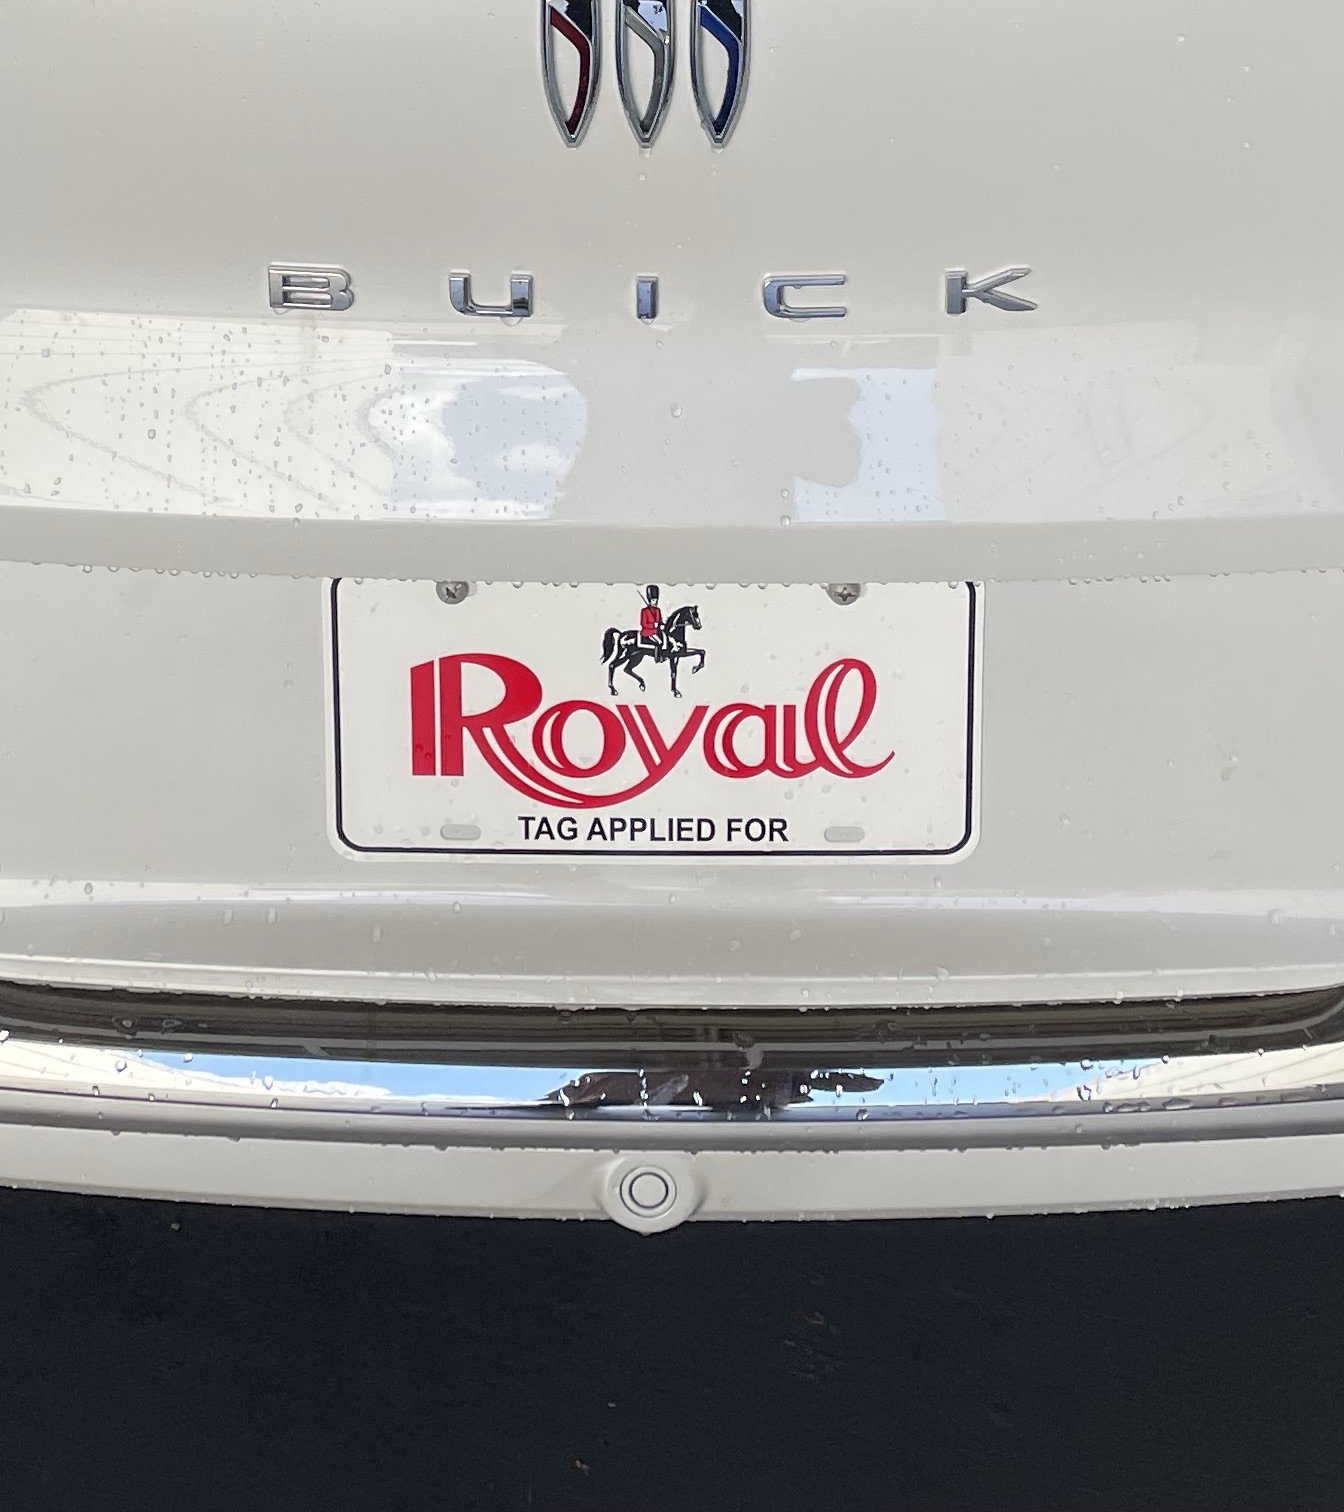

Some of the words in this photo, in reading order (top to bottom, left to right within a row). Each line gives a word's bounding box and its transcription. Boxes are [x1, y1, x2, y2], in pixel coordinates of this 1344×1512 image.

[267, 262, 1040, 320] BUICK
[409, 652, 896, 809] Royal
[517, 815, 579, 843] TAG
[587, 815, 716, 843] APPLIED
[726, 816, 789, 843] FOR
